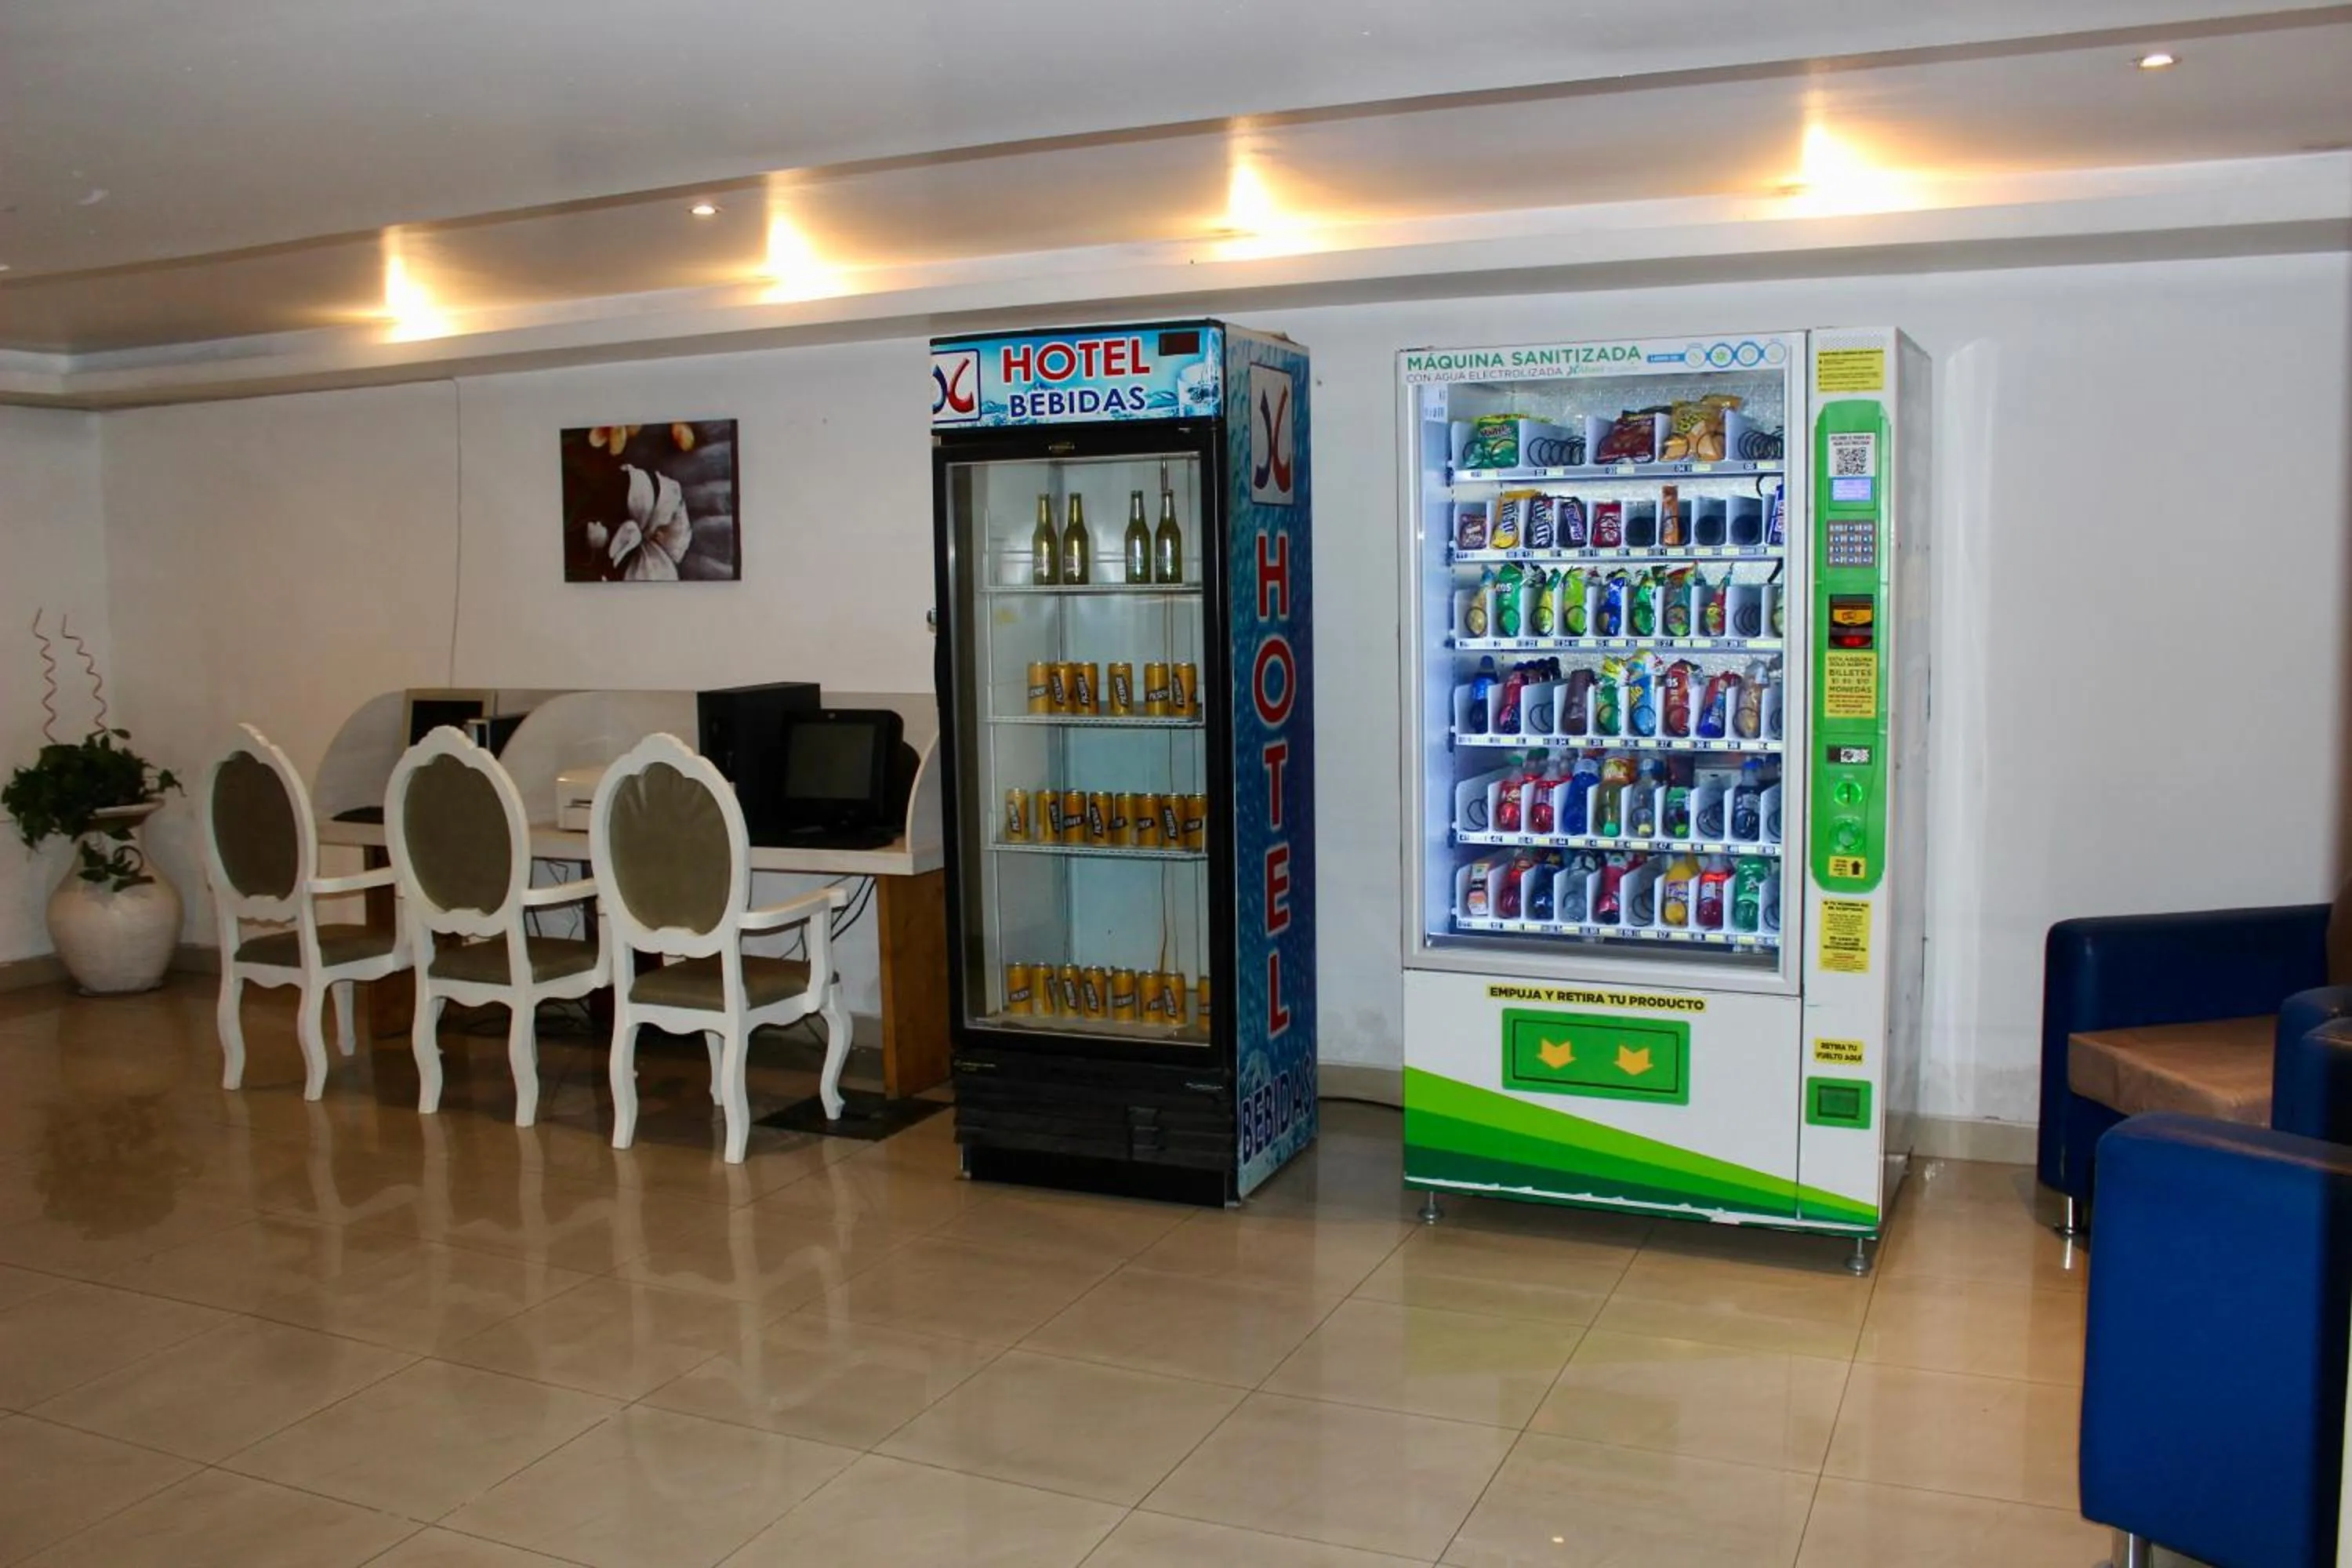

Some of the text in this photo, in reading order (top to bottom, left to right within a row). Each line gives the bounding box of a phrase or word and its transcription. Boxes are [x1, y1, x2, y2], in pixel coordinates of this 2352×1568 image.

[1002, 337, 1151, 383] HOTEL
[1407, 346, 1642, 371] MÁQUINA SANITIZADA
[1406, 372, 1431, 383] CON
[1434, 371, 1466, 382] AGUA
[1468, 367, 1563, 380] ELECTROLIZADA
[1010, 386, 1146, 418] BEBIDAS
[1253, 530, 1295, 1038] HOTEL
[1490, 987, 1705, 1011] EMPUJA Y RETIRA TU PRODUCTO
[1848, 1044, 1857, 1052] TU
[1243, 1053, 1313, 1166] BEBIDAS
